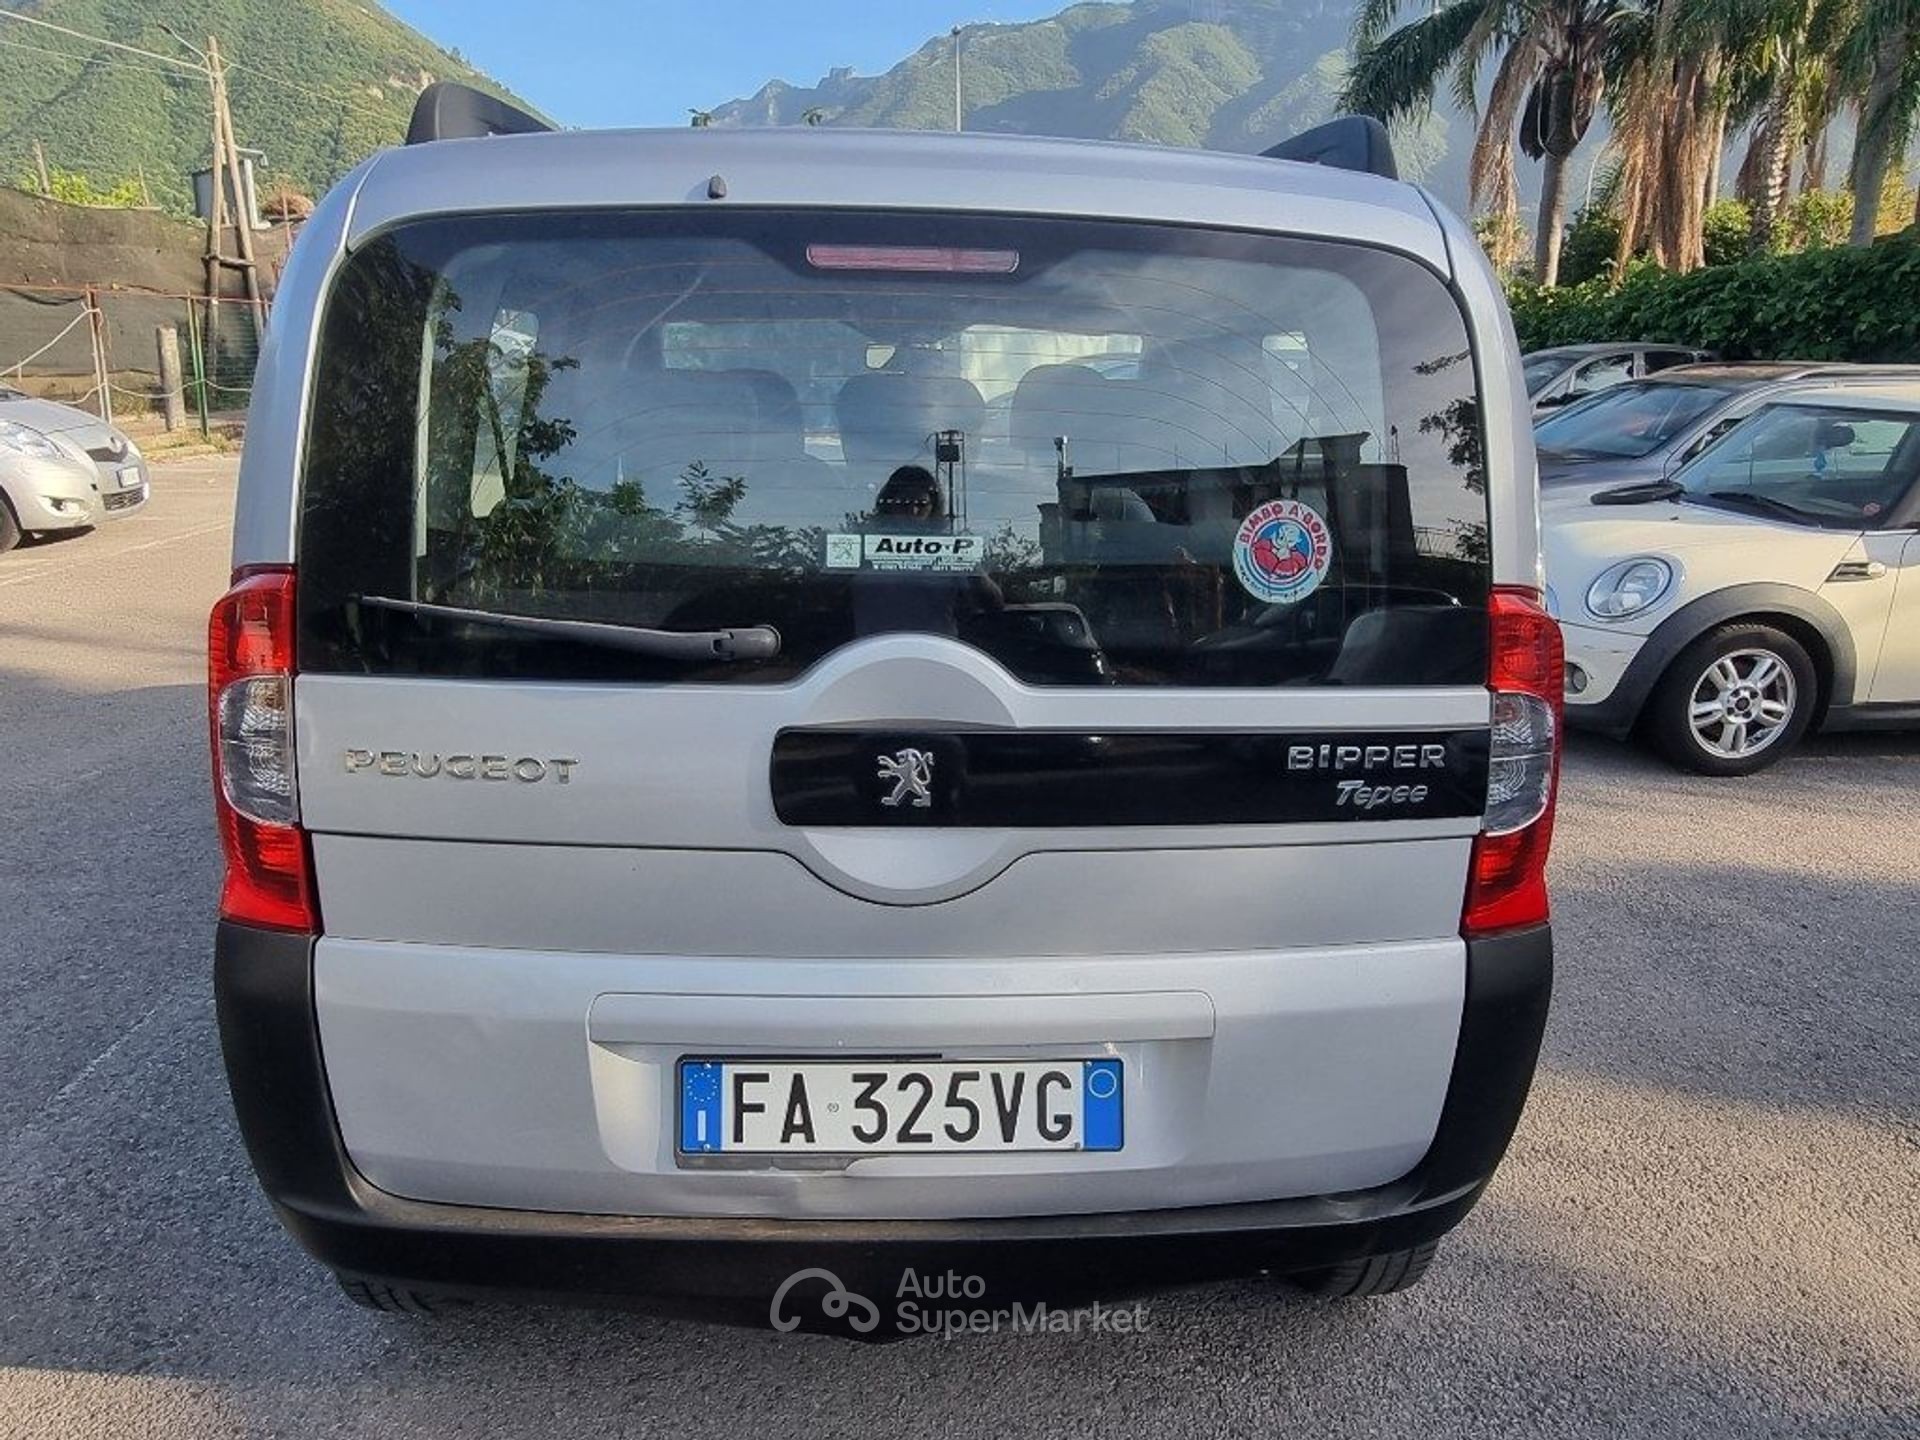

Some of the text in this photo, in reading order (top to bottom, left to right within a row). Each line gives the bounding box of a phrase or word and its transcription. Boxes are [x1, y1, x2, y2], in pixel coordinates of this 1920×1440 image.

[1239, 503, 1283, 545] BIMBO
[345, 749, 580, 785] PEUGEOT
[1287, 744, 1446, 770] BIPPER
[1335, 780, 1429, 810] Tepee
[732, 1073, 817, 1144] FA
[851, 1071, 1073, 1144] 325VG
